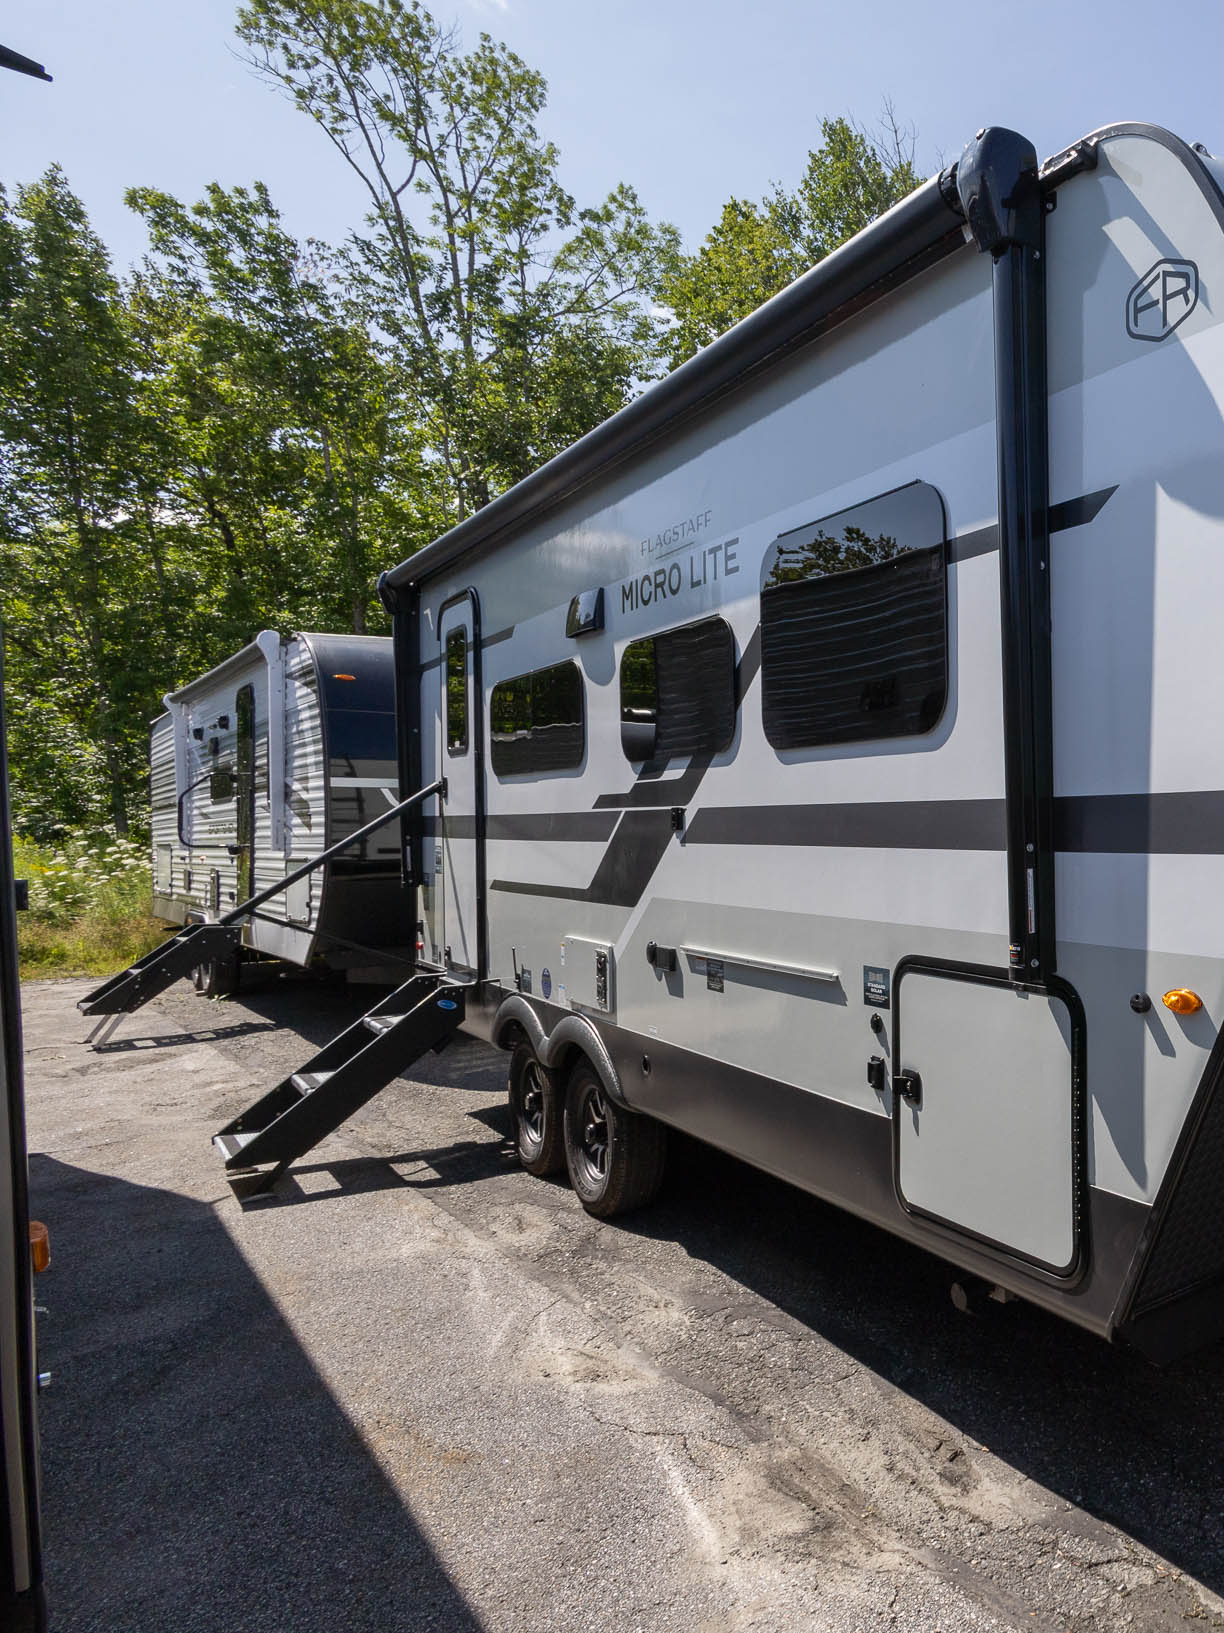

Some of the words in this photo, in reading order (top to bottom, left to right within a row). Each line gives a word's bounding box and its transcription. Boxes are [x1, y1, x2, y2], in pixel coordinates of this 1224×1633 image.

[641, 509, 712, 556] FLAGSTAFF
[621, 562, 682, 614] MICRO
[690, 536, 740, 589] LITE
